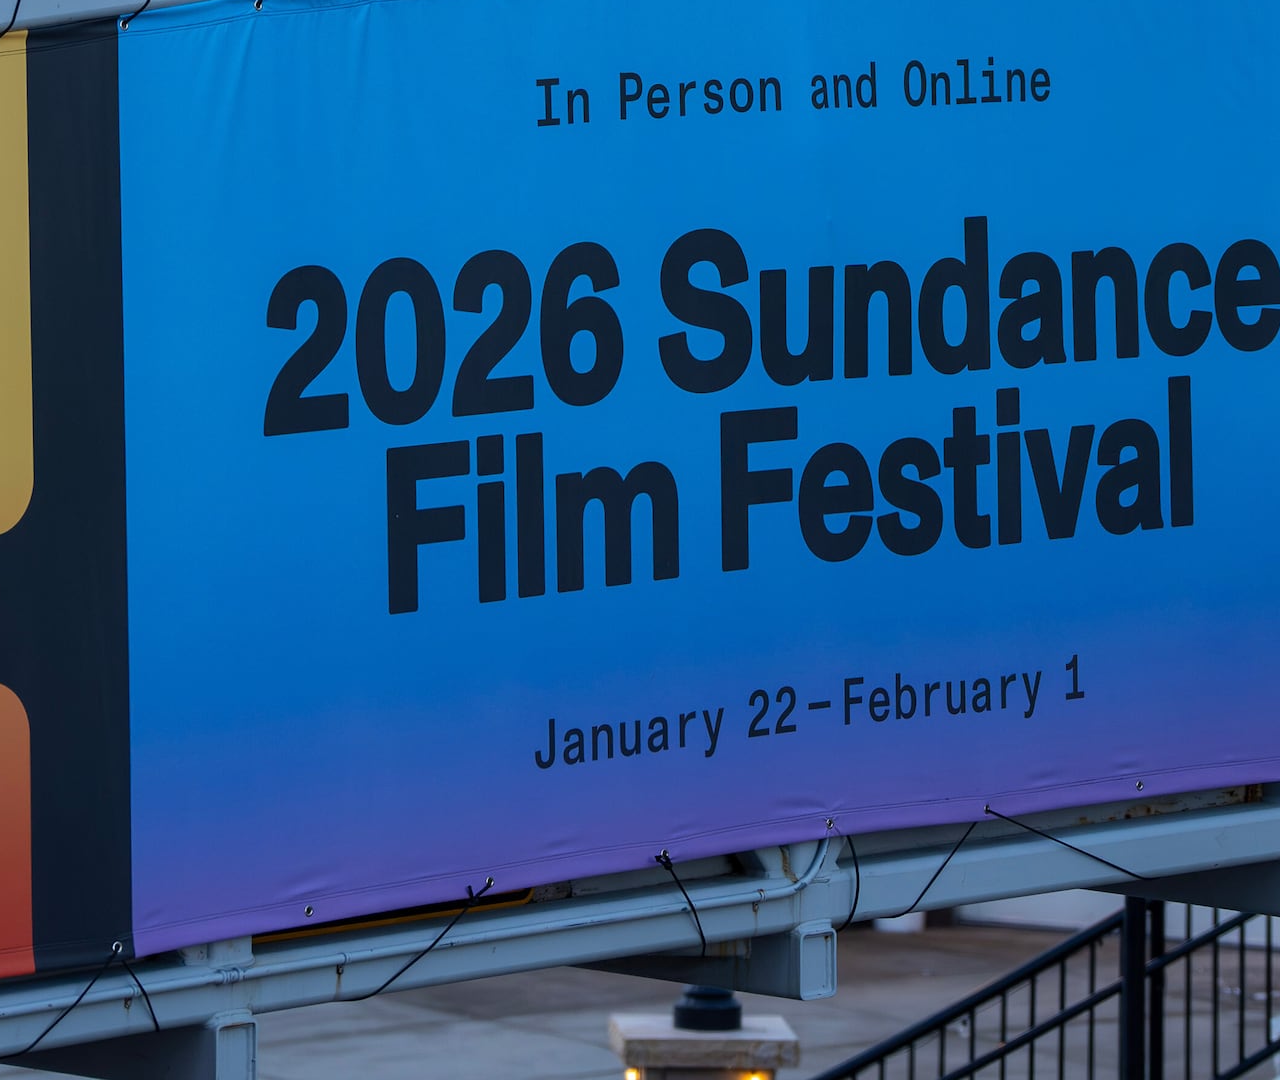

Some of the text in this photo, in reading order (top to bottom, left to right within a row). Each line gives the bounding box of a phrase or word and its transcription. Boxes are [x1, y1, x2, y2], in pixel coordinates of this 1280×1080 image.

[536, 56, 1051, 127] In Person and Online
[263, 241, 624, 437] 2026
[386, 375, 1194, 615] Film Festival
[534, 707, 724, 770] January
[1065, 654, 1085, 701] 1
